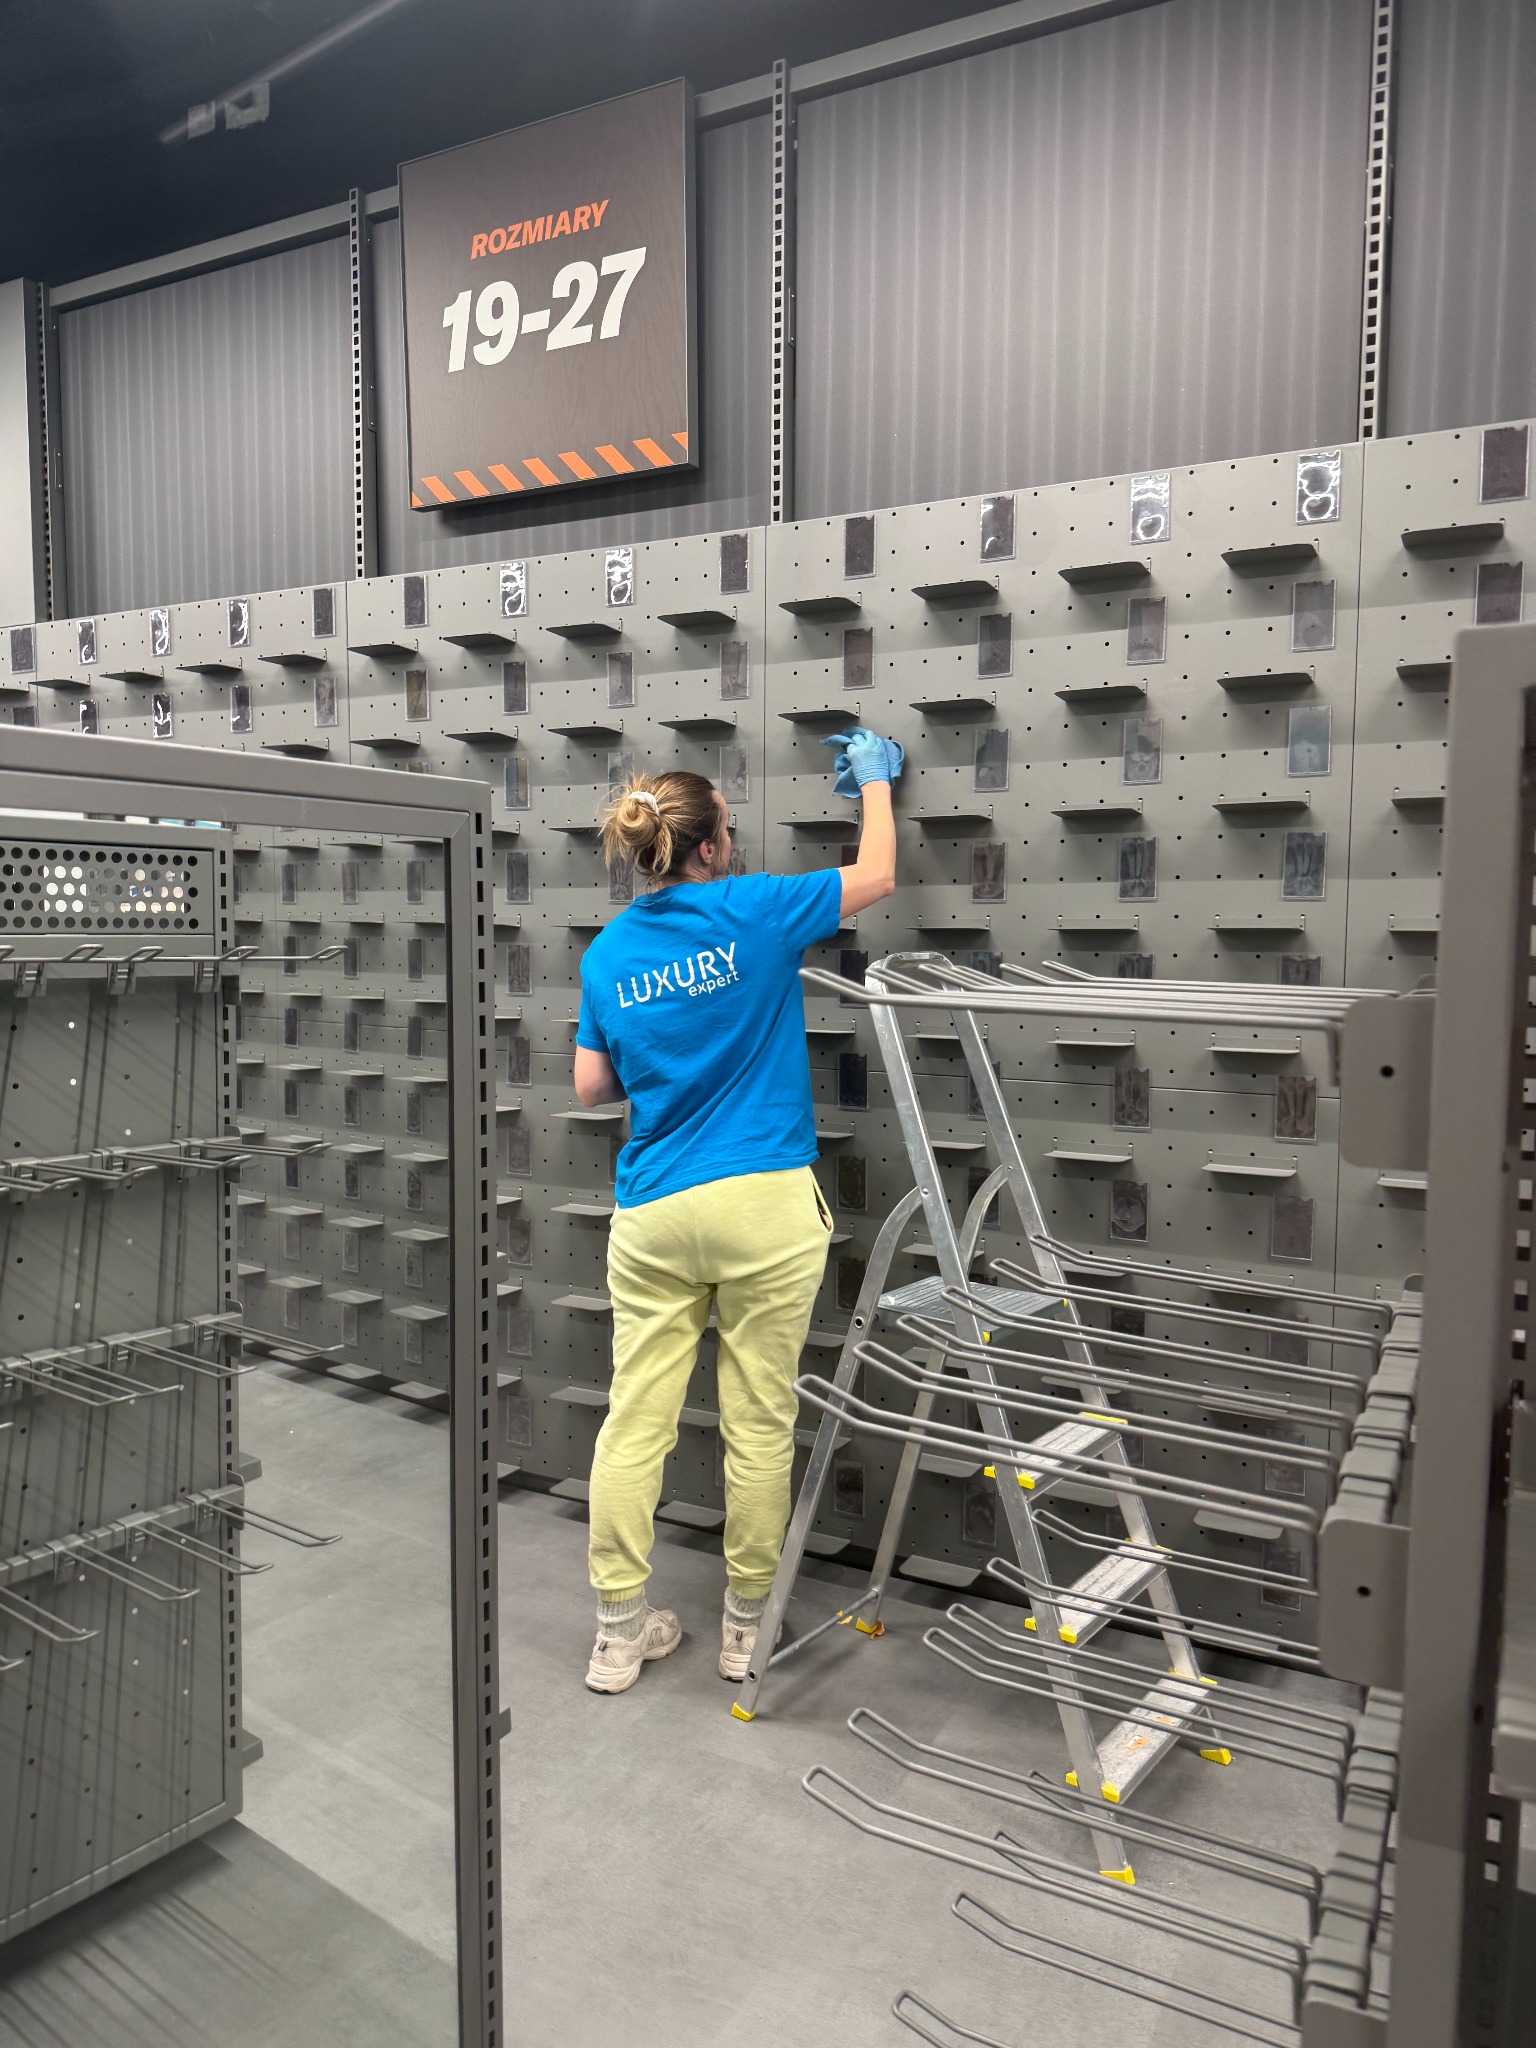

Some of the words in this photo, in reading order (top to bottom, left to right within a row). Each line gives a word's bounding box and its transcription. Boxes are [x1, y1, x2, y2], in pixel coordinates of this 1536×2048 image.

[471, 200, 609, 260] ROZMIARY
[442, 246, 647, 373] 19-27
[616, 941, 736, 1009] LUXURY
[688, 970, 740, 997] expert
